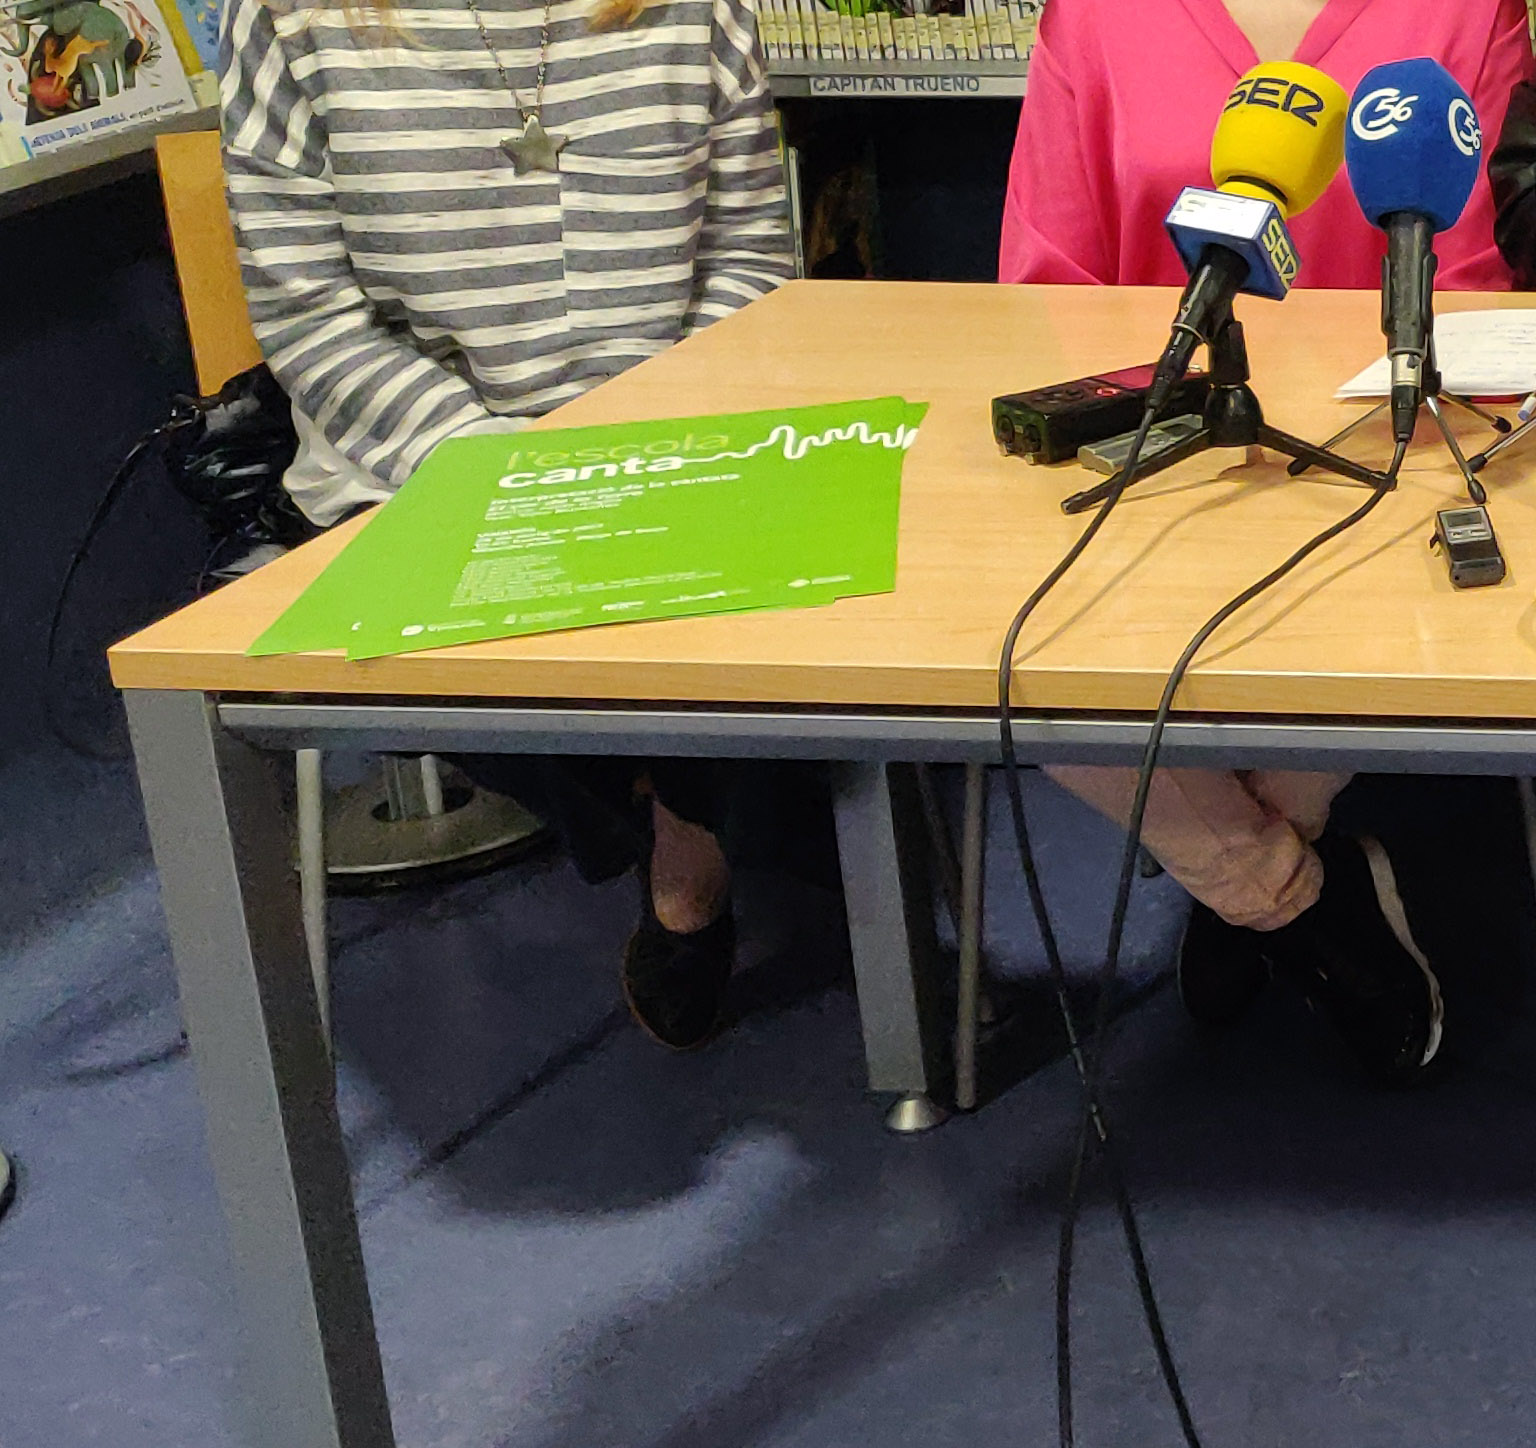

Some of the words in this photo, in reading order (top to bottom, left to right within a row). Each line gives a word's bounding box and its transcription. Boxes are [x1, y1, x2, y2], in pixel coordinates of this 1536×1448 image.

[812, 75, 899, 94] CAPITAN
[902, 75, 981, 94] TRUENO
[1223, 77, 1325, 127] SER
[1261, 216, 1299, 292] SER
[498, 456, 684, 489] canta
